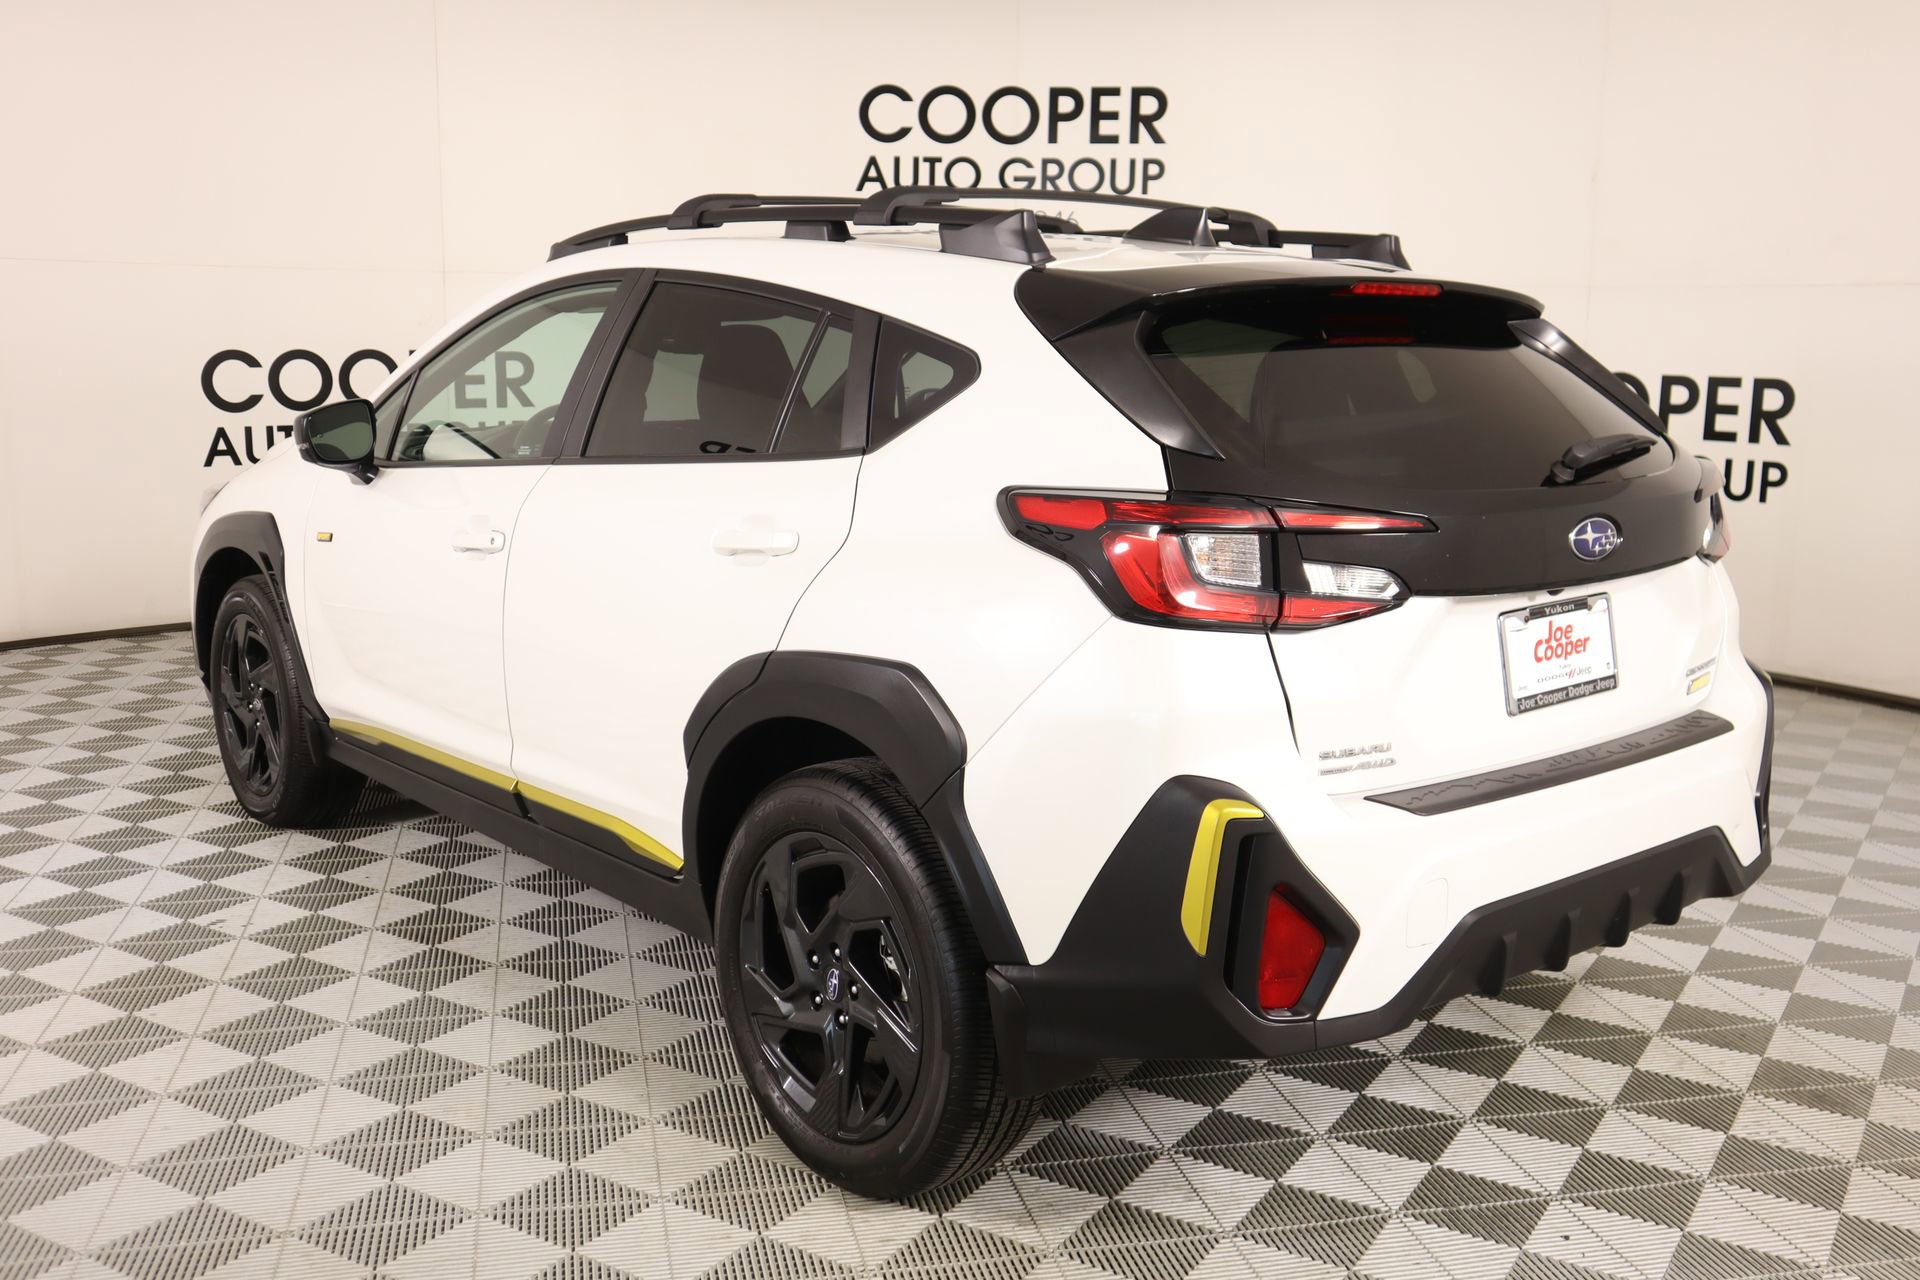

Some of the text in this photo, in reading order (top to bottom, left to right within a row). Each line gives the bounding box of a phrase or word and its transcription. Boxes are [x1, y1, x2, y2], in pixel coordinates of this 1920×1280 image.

[859, 84, 1168, 144] COOPER
[856, 156, 1166, 195] AUTO GROUP
[1544, 603, 1575, 616] Yukon
[1545, 620, 1574, 644] Joe
[1534, 636, 1591, 663] Cooper
[1519, 677, 1616, 711] Joe Cooper Dodge Jeep
